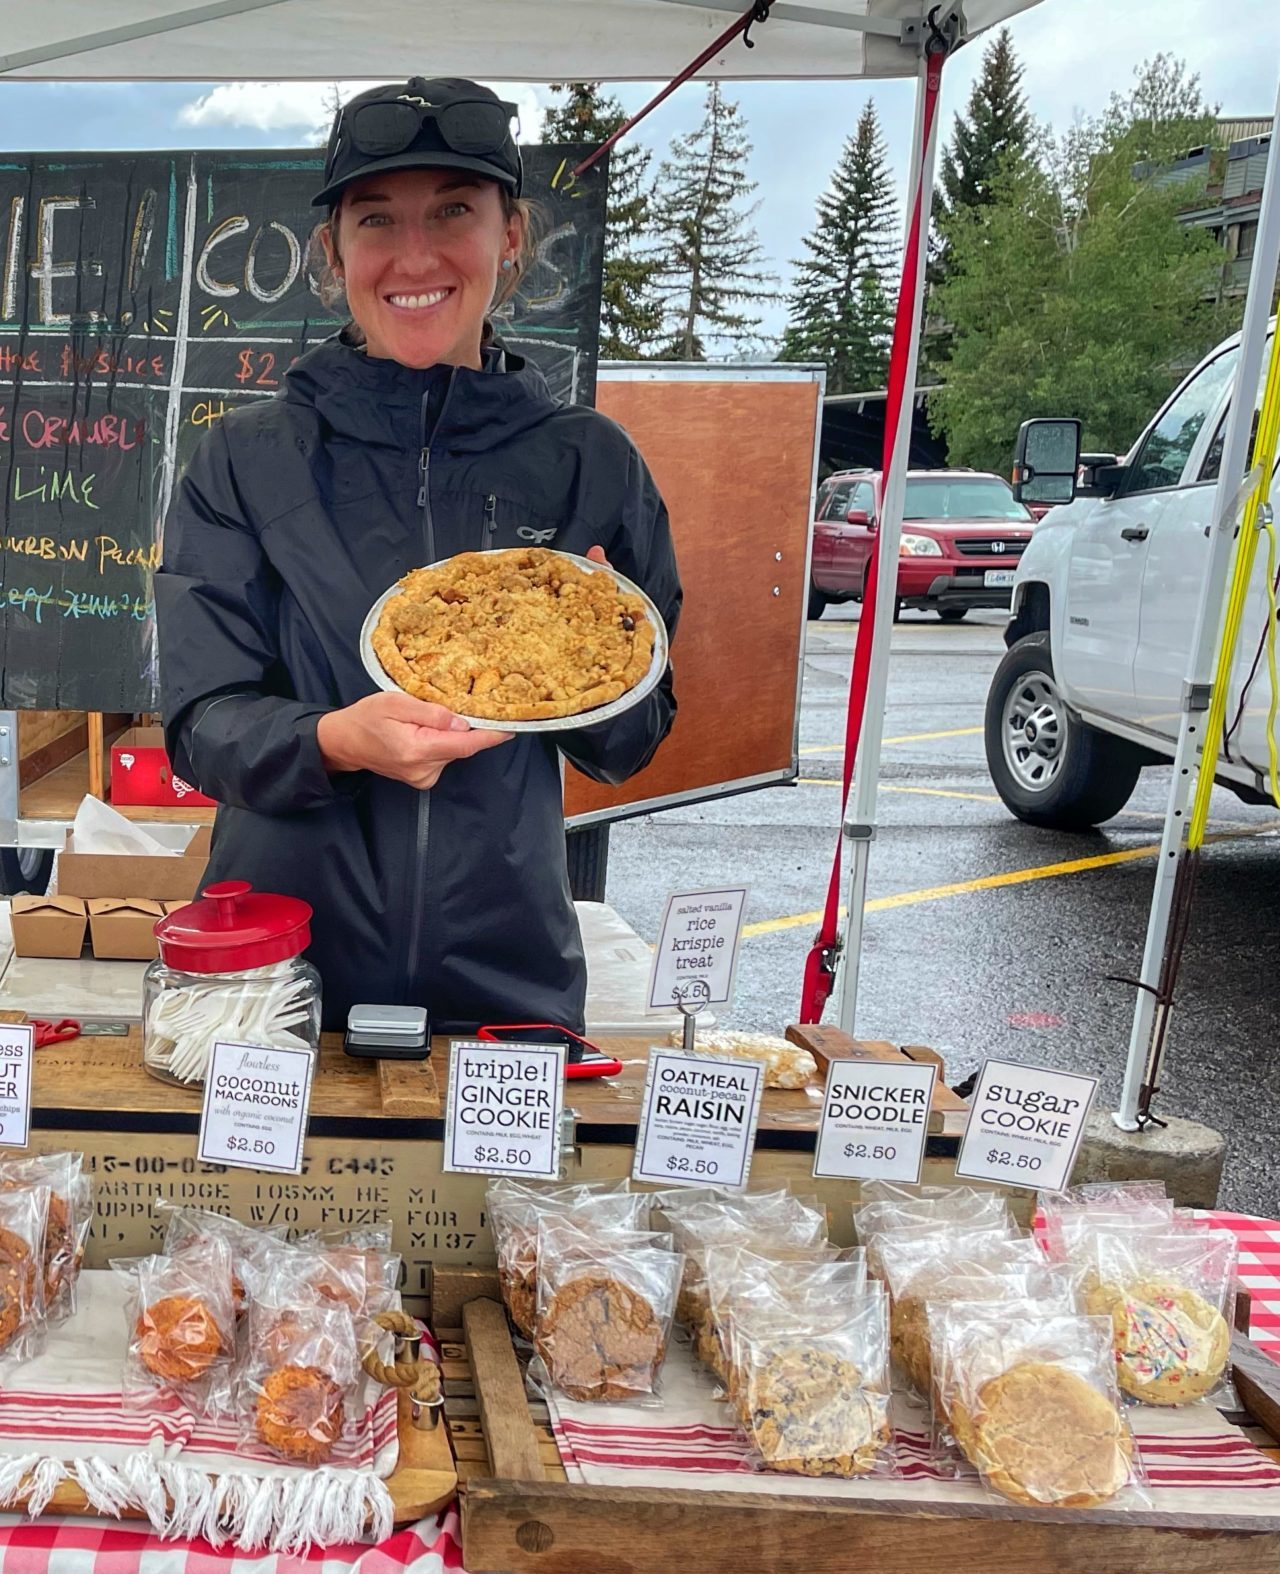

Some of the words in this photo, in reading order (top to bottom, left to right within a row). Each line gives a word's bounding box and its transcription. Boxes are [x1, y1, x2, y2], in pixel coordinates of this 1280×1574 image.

[23, 410, 145, 451] CRMBL
[686, 917, 716, 931] rice
[672, 935, 725, 952] krispie
[676, 954, 713, 969] treat
[237, 1052, 280, 1072] flourless
[464, 1058, 547, 1084] triple!
[217, 1075, 300, 1097] coconut
[661, 1069, 750, 1091] OATMEAL
[215, 1090, 298, 1109] MACAROONS
[461, 1085, 551, 1108] GINGER
[660, 1084, 746, 1102] coconut-pecan
[831, 1084, 925, 1104] SNICKER
[986, 1085, 1079, 1115] sugar
[460, 1107, 550, 1130] COOKIE
[656, 1095, 745, 1124] RAISIN
[828, 1104, 924, 1124] DOODLE
[981, 1109, 1071, 1138] COOKIE
[227, 1135, 275, 1154] $2.50
[844, 1143, 896, 1160] $2.50
[474, 1145, 531, 1165] $2.50
[667, 1155, 719, 1175] $2.50
[986, 1148, 1041, 1170] $2.50
[99, 1182, 230, 1199] ARTRIDGE
[97, 1202, 160, 1219] UPPL
[407, 1210, 457, 1227] FOR
[411, 1233, 477, 1249] M137
